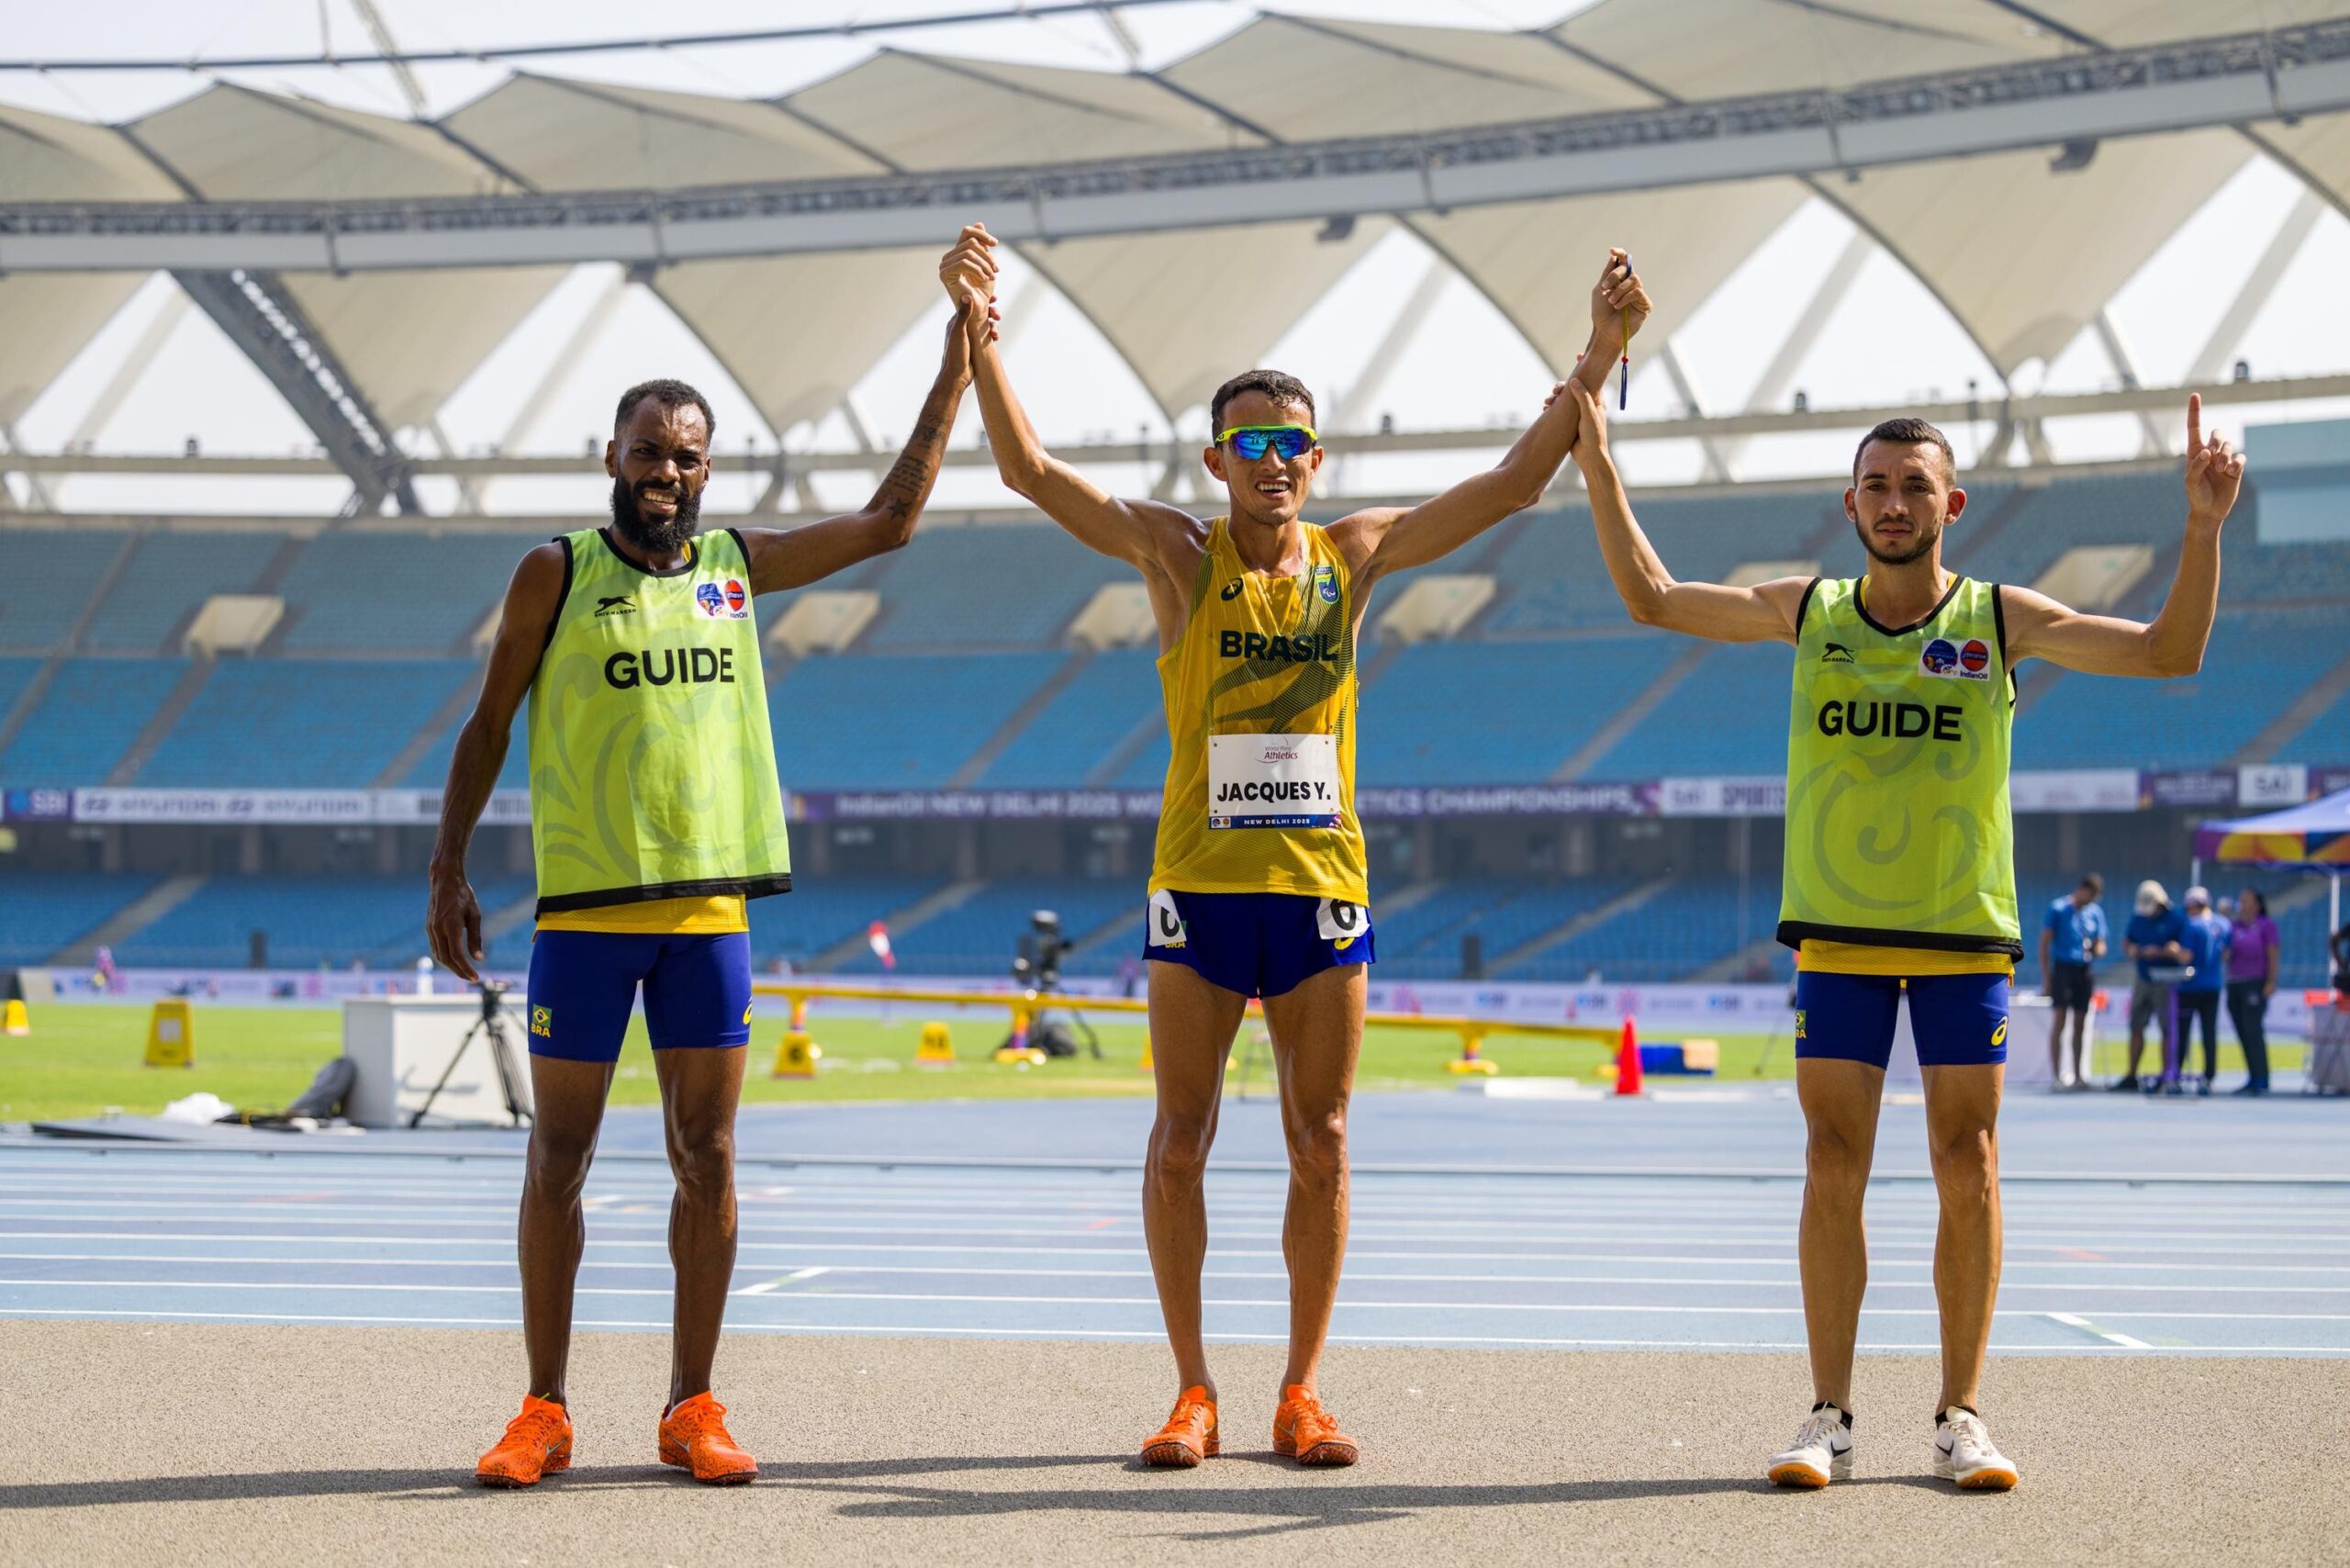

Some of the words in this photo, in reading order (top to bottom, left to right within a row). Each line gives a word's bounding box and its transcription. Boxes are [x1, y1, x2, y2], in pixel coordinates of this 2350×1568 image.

[1220, 630, 1338, 662] BRASIL
[604, 648, 735, 689] GUIDE
[1960, 670, 1988, 679] IndianOil
[1818, 700, 1964, 742] GUIDE
[1264, 751, 1298, 760] Athletics
[1217, 781, 1311, 803] JACQUES
[1314, 782, 1331, 801] Y.
[531, 1023, 551, 1038] BRA
